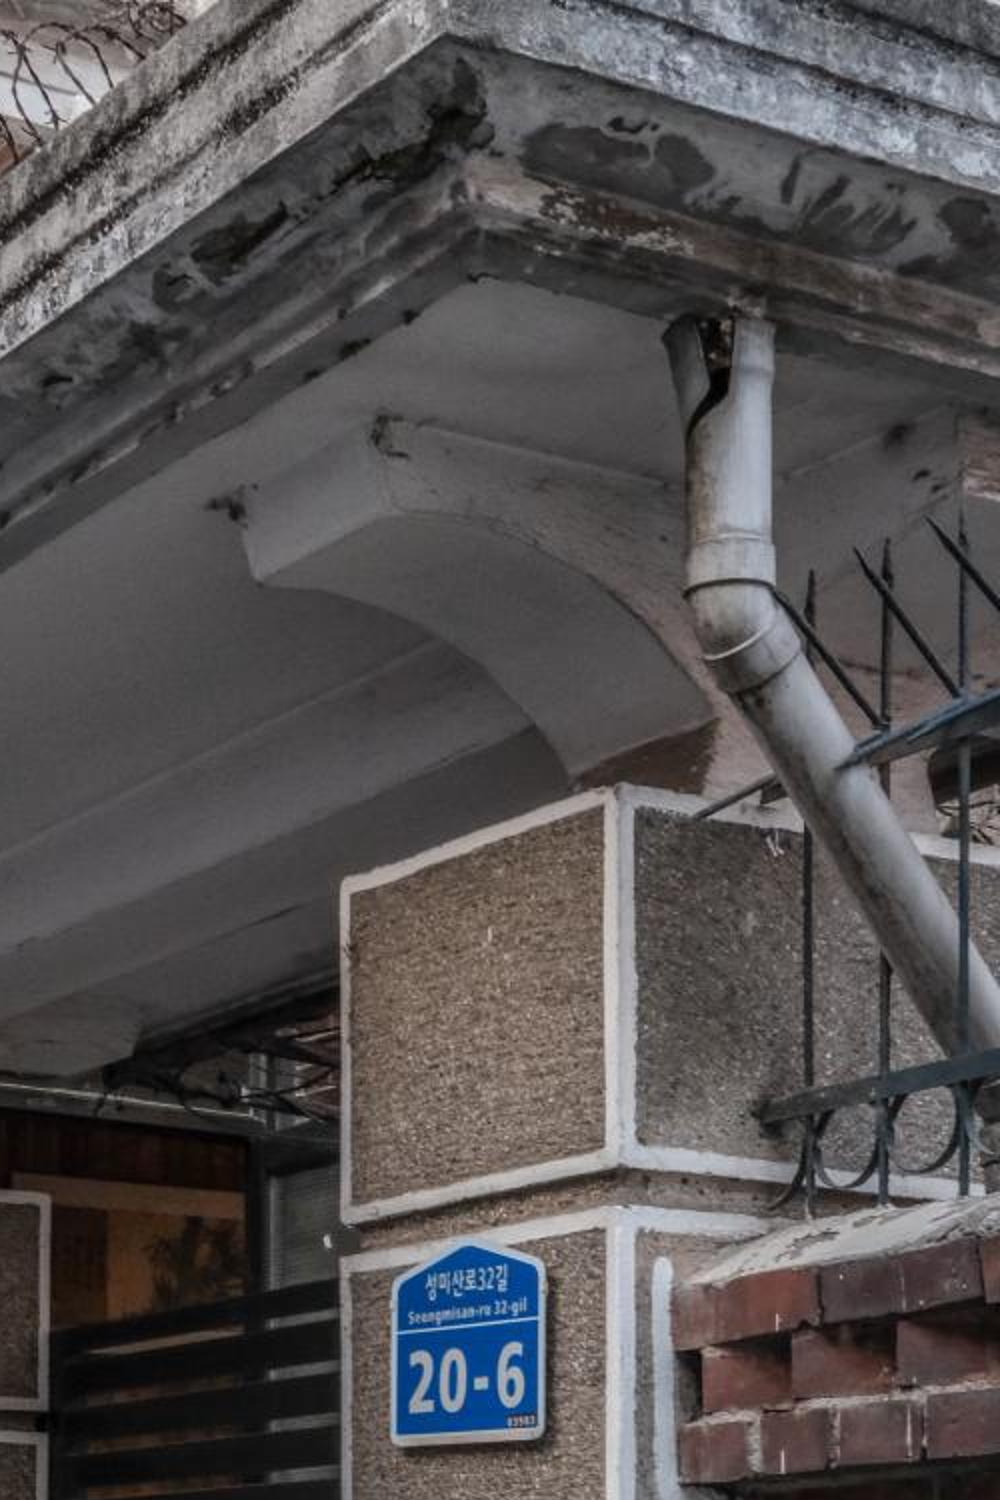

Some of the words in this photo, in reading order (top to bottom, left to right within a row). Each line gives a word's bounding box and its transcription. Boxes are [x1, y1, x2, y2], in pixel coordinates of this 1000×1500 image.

[425, 1264, 508, 1301] 성미산로32길
[408, 1308, 490, 1325] Seongmisan-ro
[494, 1296, 527, 1316] 32-gil
[409, 1341, 525, 1414] 20-6
